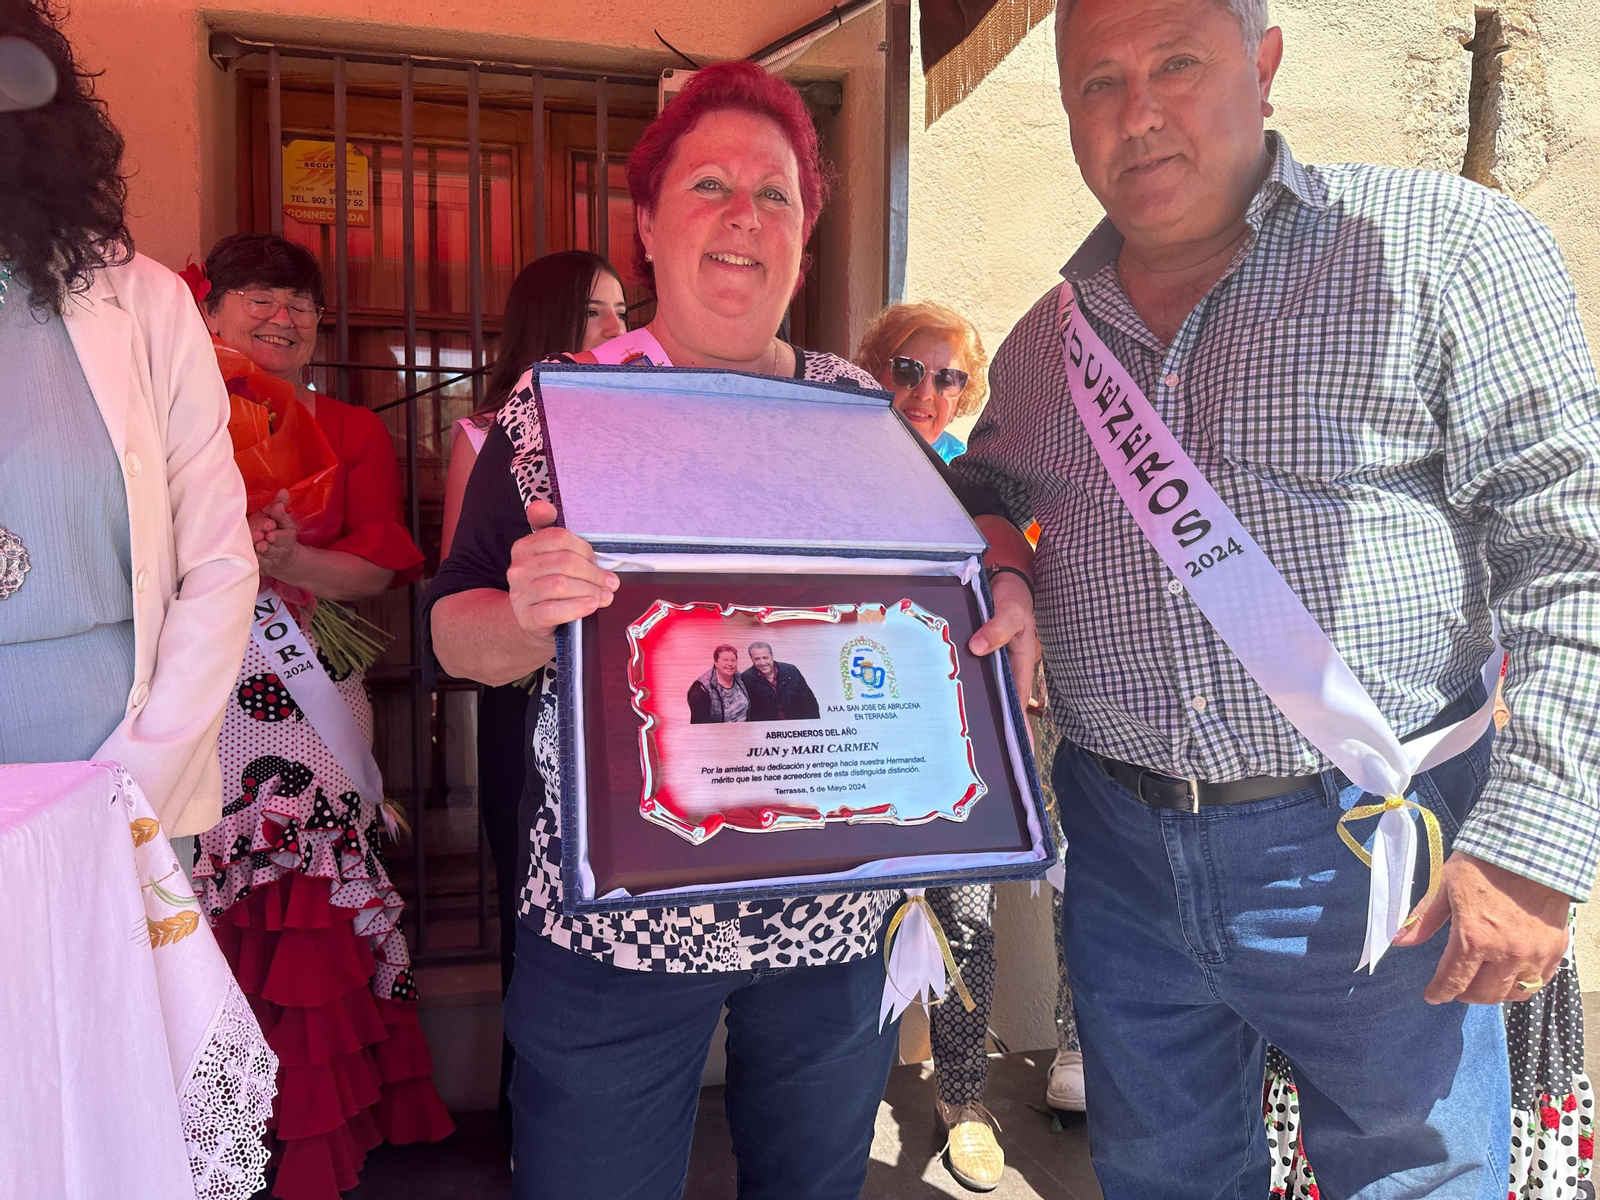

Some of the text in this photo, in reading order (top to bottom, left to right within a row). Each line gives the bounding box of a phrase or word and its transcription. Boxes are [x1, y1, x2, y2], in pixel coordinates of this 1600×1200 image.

[328, 188, 363, 196] SERETAT
[291, 195, 309, 203] TEL.
[311, 197, 327, 205] 902
[287, 208, 365, 222] CONNECDA
[1184, 536, 1245, 578] 2024
[283, 660, 314, 679] 2024
[861, 703, 877, 711] JOSE
[887, 702, 921, 710] ABRUCENA
[864, 712, 898, 720] TERRASSA
[766, 727, 858, 739] ABRUCENEROS DEL AÑO
[746, 742, 879, 757] JUAN y MARI CARMEN
[701, 766, 714, 774] Por
[724, 764, 755, 773] amistad,
[767, 761, 805, 771] dedicación
[806, 762, 811, 770] y
[812, 761, 838, 769] entrega
[839, 759, 858, 767] hacia
[859, 758, 885, 766] nuestra
[886, 756, 927, 764] Hermandad,
[711, 776, 735, 784] mérito
[736, 776, 750, 784] que
[763, 773, 782, 781] hace
[782, 771, 822, 780] acreedores
[850, 767, 887, 777] distinguida
[887, 765, 921, 774] distinción.
[774, 787, 808, 795] Terrassa,
[827, 784, 847, 793] Mayo
